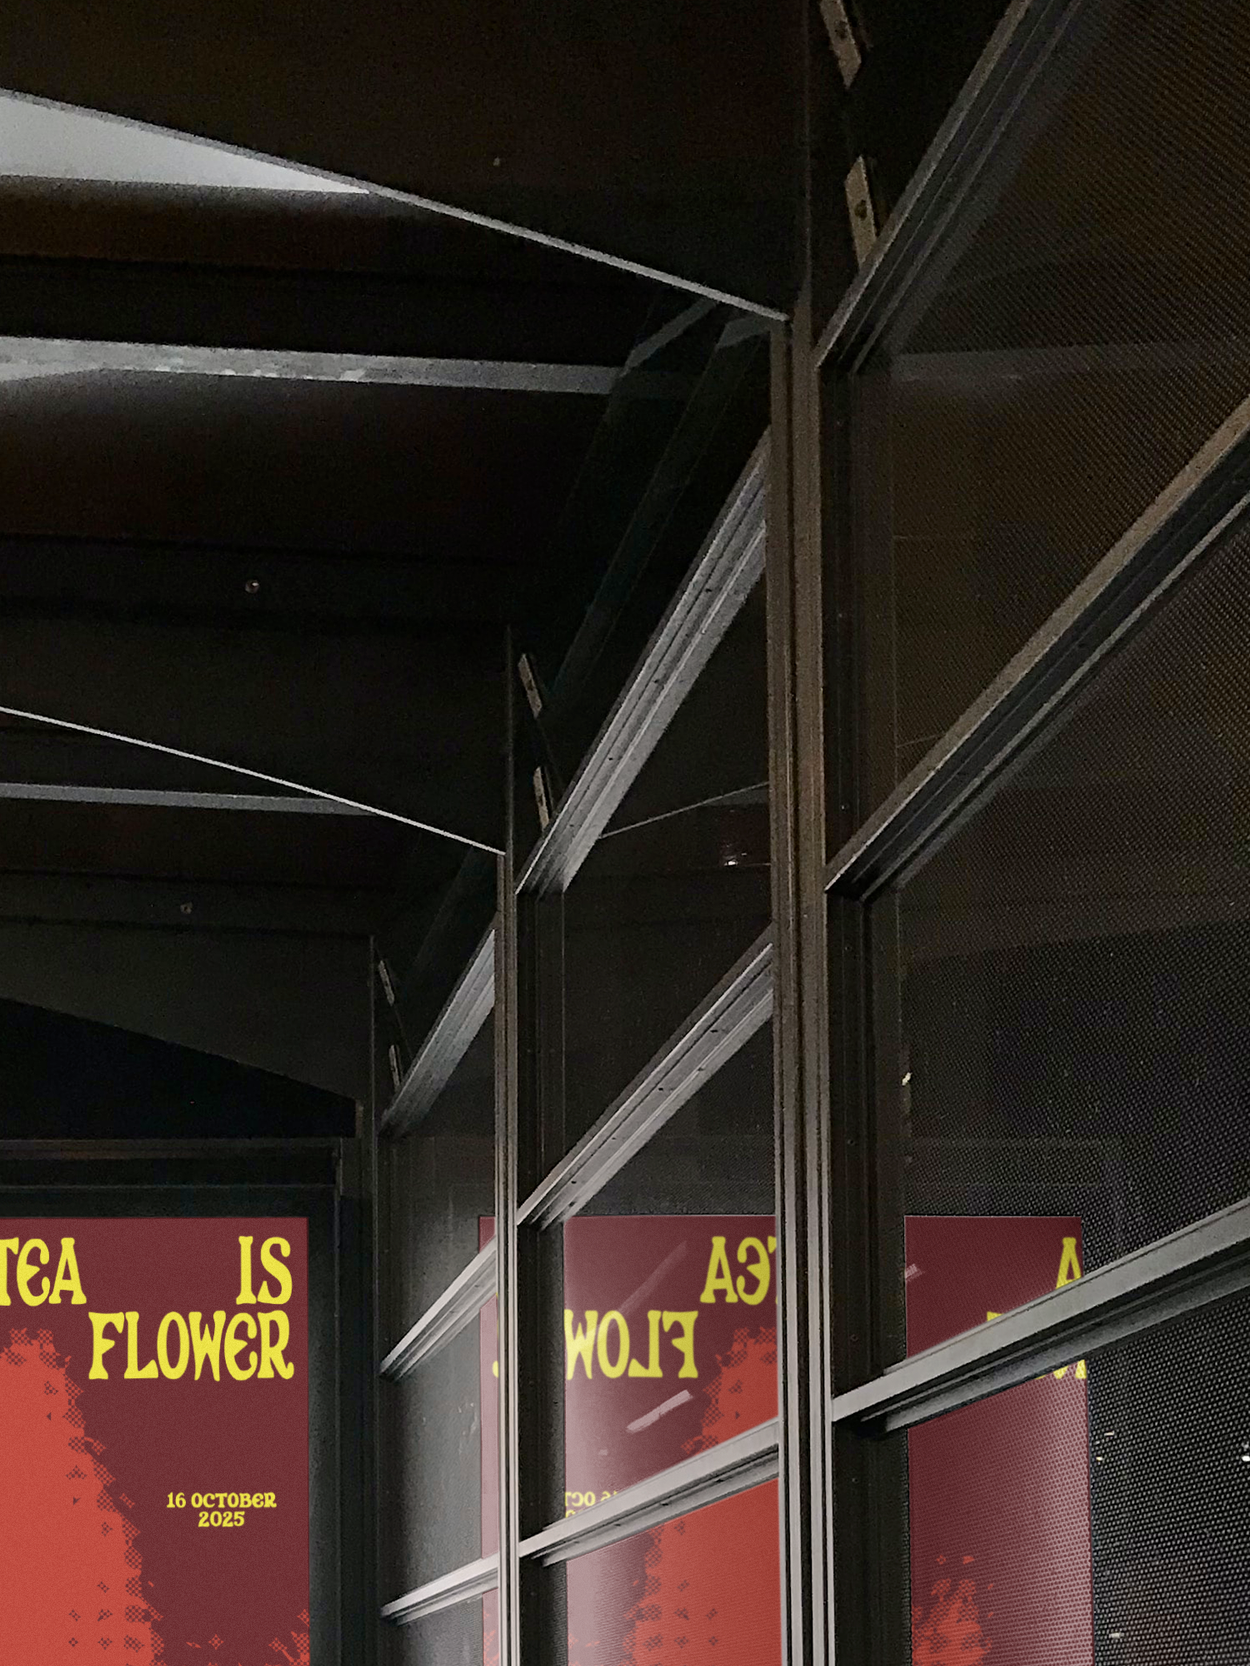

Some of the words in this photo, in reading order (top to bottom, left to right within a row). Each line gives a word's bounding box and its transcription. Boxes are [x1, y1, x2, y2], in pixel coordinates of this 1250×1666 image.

[236, 1236, 293, 1306] IS
[88, 1310, 295, 1381] FLOWER
[166, 1491, 187, 1509] 16
[190, 1491, 278, 1509] OCTOBER
[197, 1511, 246, 1528] 2025
